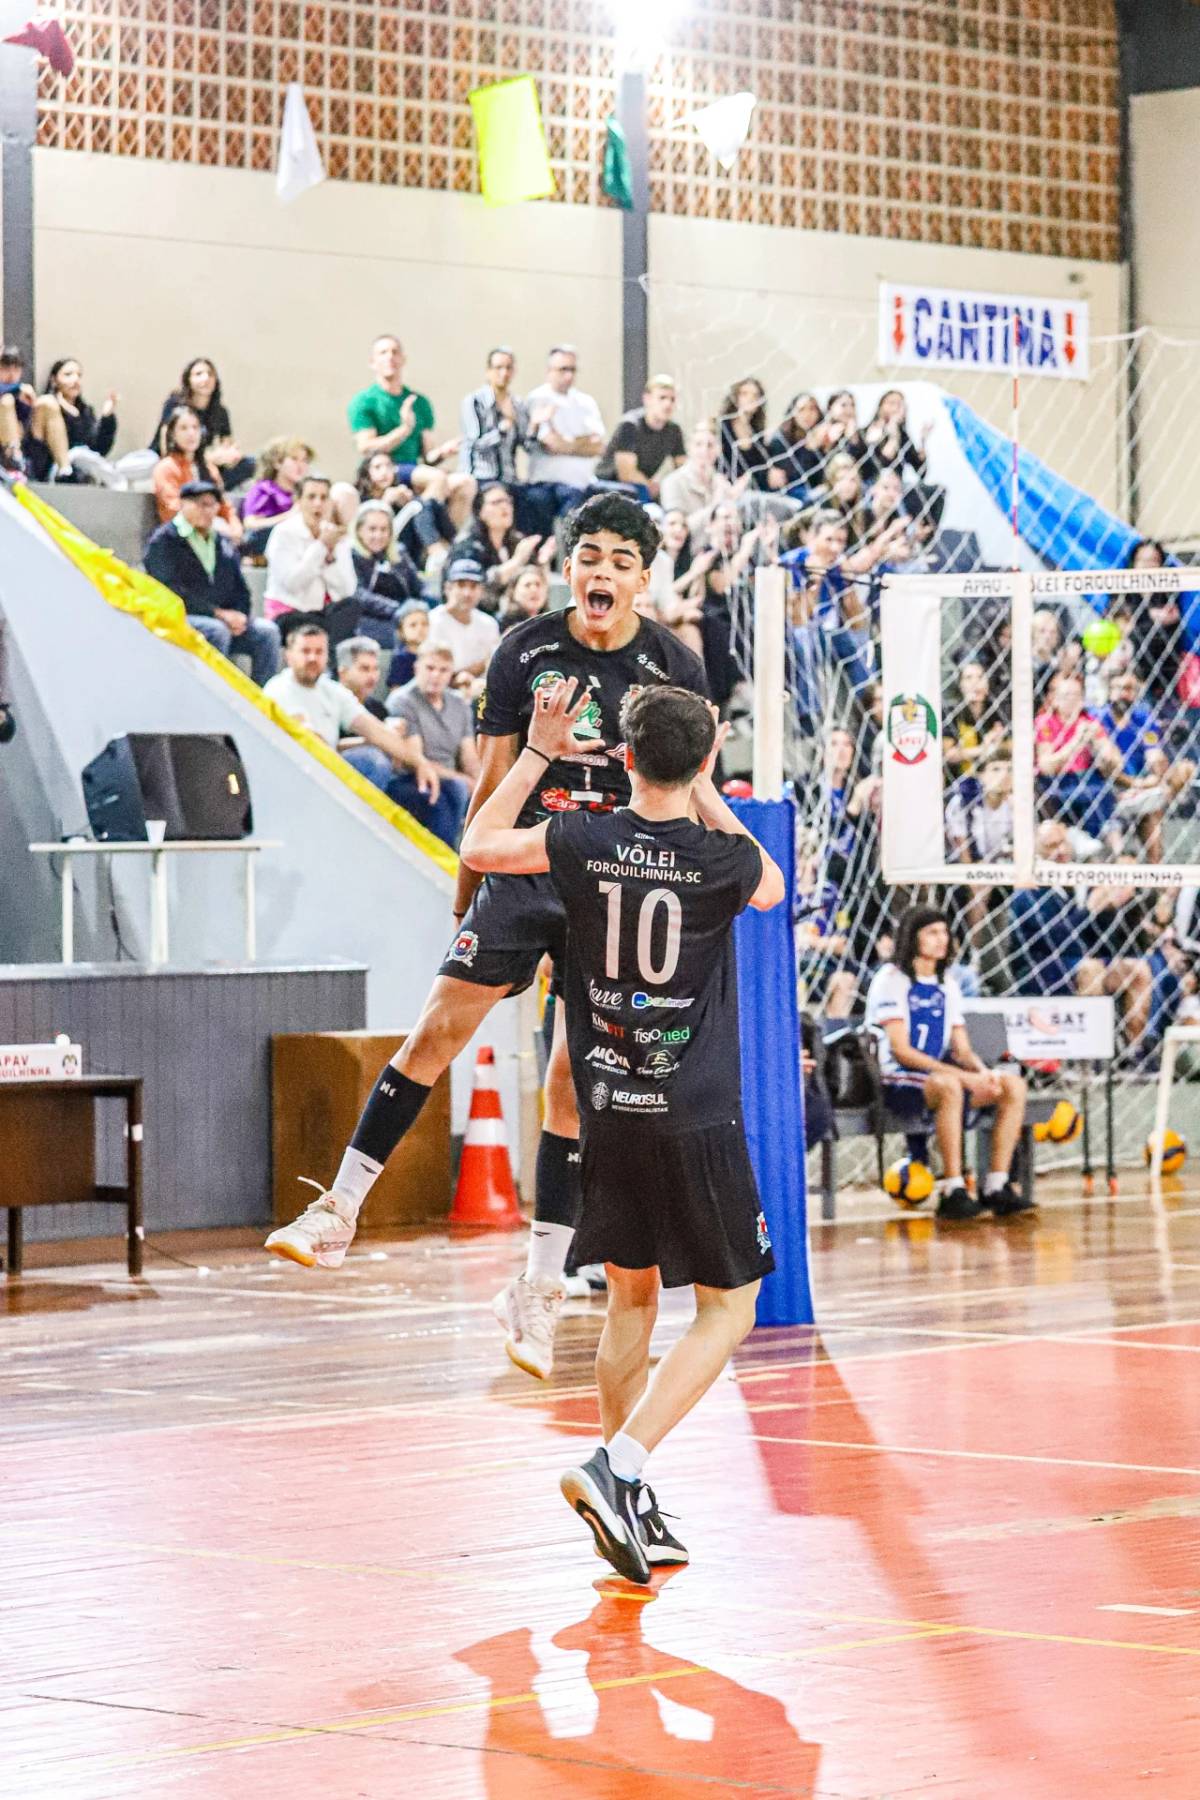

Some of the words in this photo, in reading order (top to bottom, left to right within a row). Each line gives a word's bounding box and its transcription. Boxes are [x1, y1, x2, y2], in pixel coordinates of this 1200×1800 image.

[914, 298, 1057, 368] CANTINA
[616, 844, 676, 869] VÔLEI
[586, 859, 702, 884] FORQUILHINHA-SC
[598, 880, 682, 986] 10
[916, 1023, 930, 1051] 1
[612, 1089, 668, 1106] NEUROSUL
